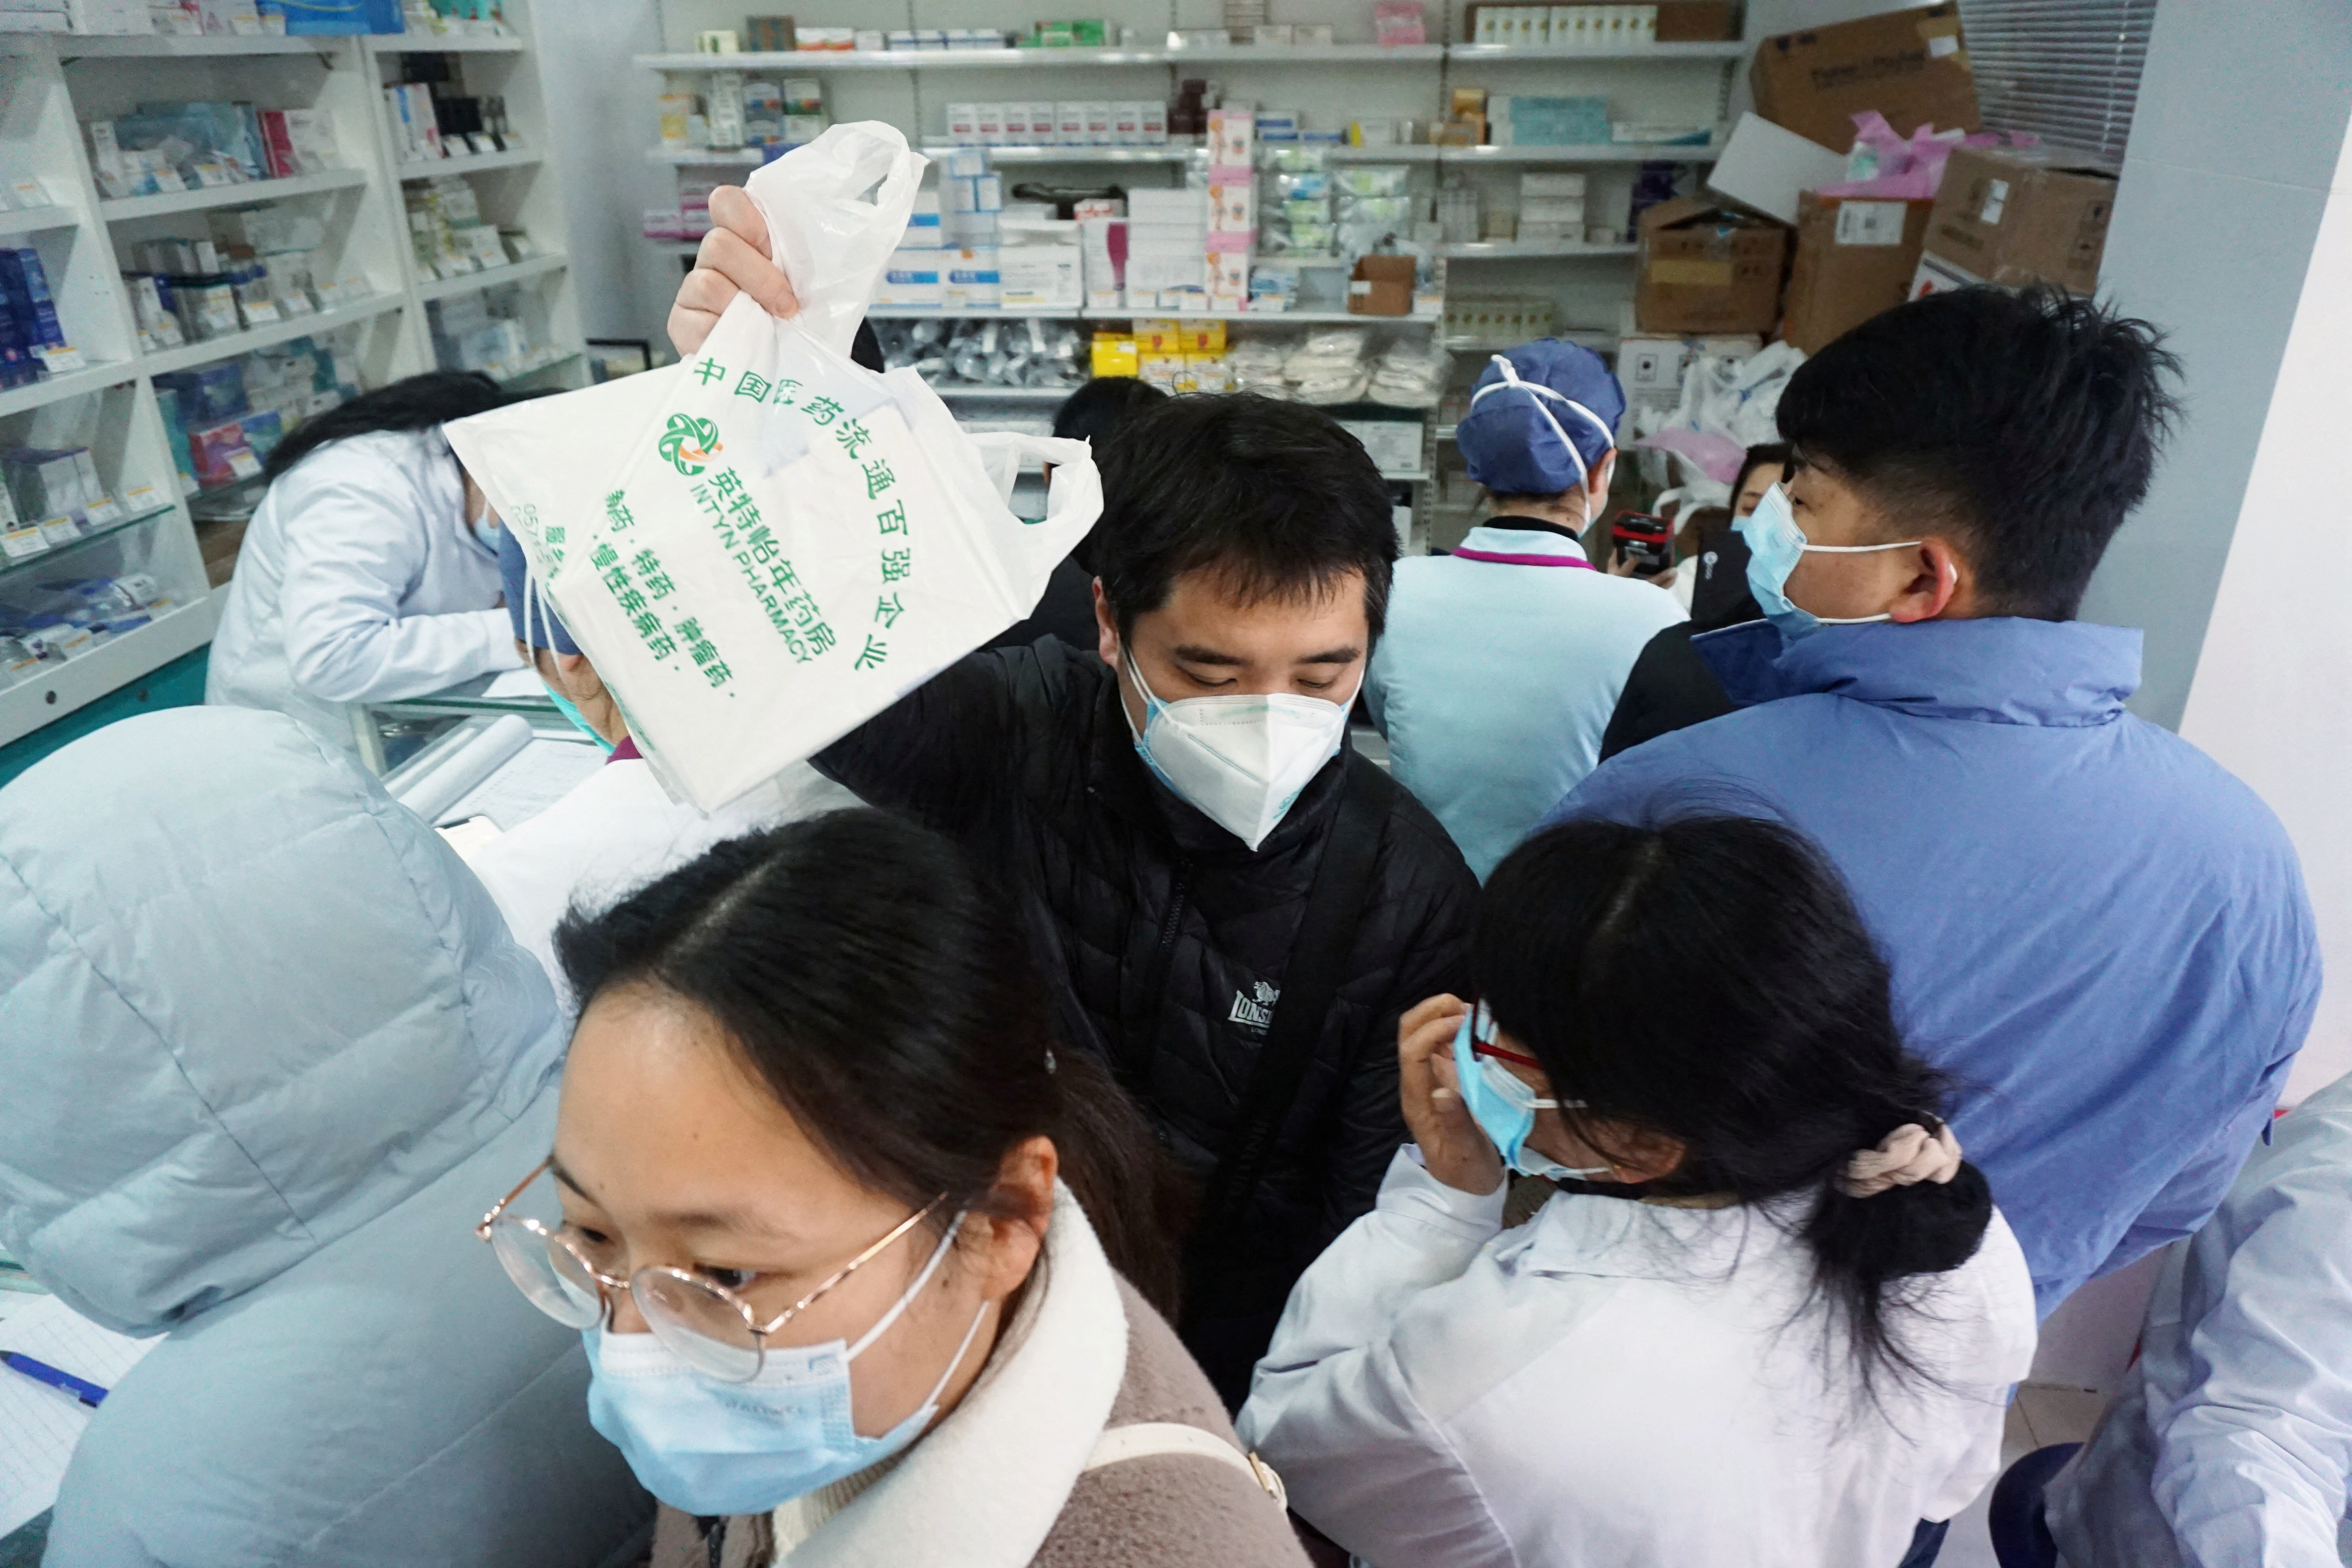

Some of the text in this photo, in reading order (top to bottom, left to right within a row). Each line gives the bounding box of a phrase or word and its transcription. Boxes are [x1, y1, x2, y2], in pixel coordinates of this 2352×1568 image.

[690, 483, 813, 664] INTYN PHARMACY
[693, 358, 911, 671] 中国医药流通百强企业
[707, 466, 836, 655] 英特怡年药房
